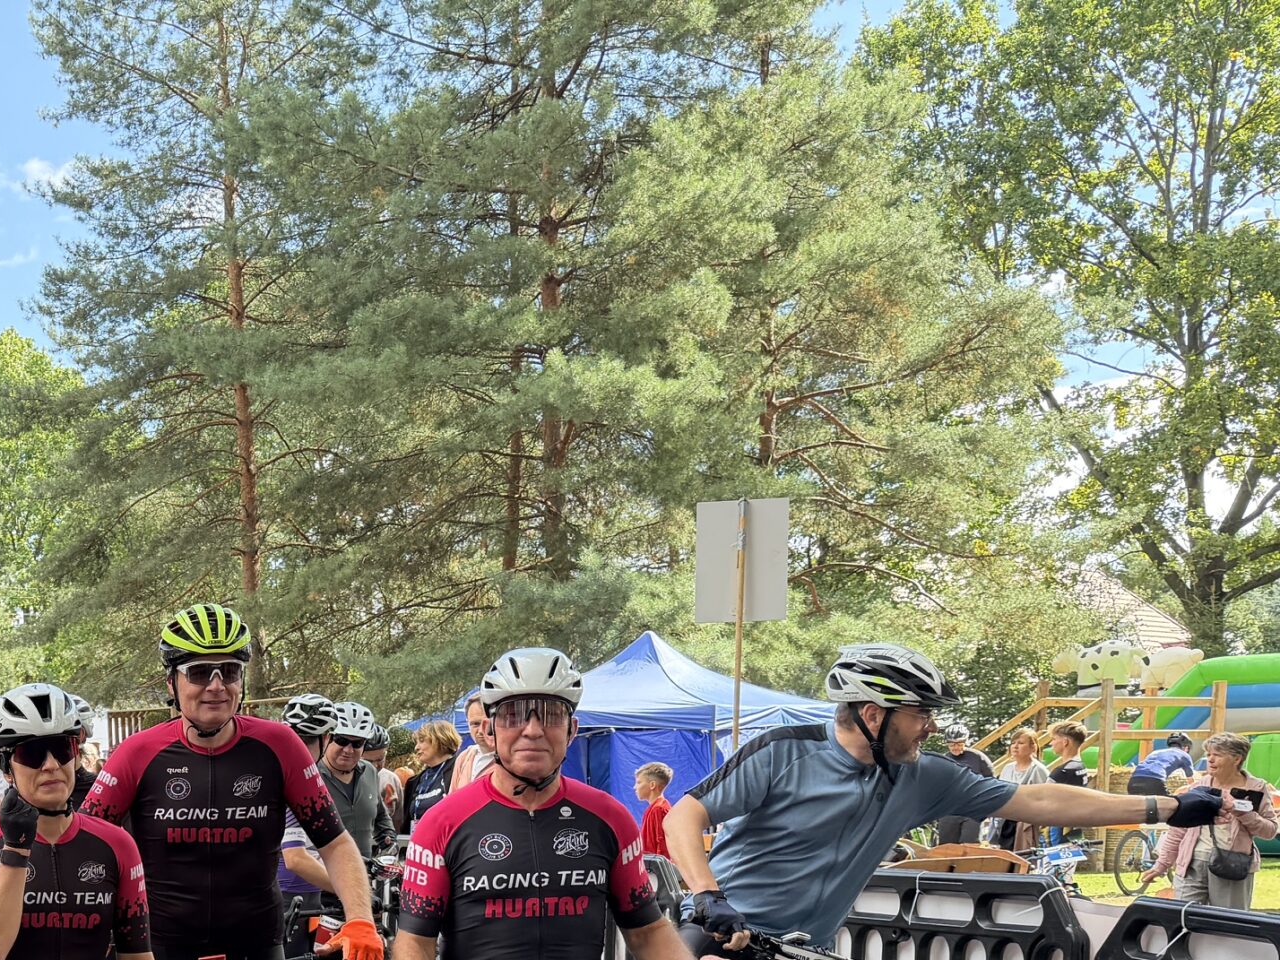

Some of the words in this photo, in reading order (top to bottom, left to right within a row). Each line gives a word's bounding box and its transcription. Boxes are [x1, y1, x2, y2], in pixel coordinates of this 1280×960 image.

[154, 808, 219, 821] RACING
[225, 805, 268, 820] TEAM
[167, 827, 253, 843] HURTAP
[463, 872, 549, 891] RACING
[558, 869, 606, 886] TEAM
[24, 892, 67, 904] CING
[74, 892, 112, 905] TEAM
[485, 896, 589, 918] HURTAP
